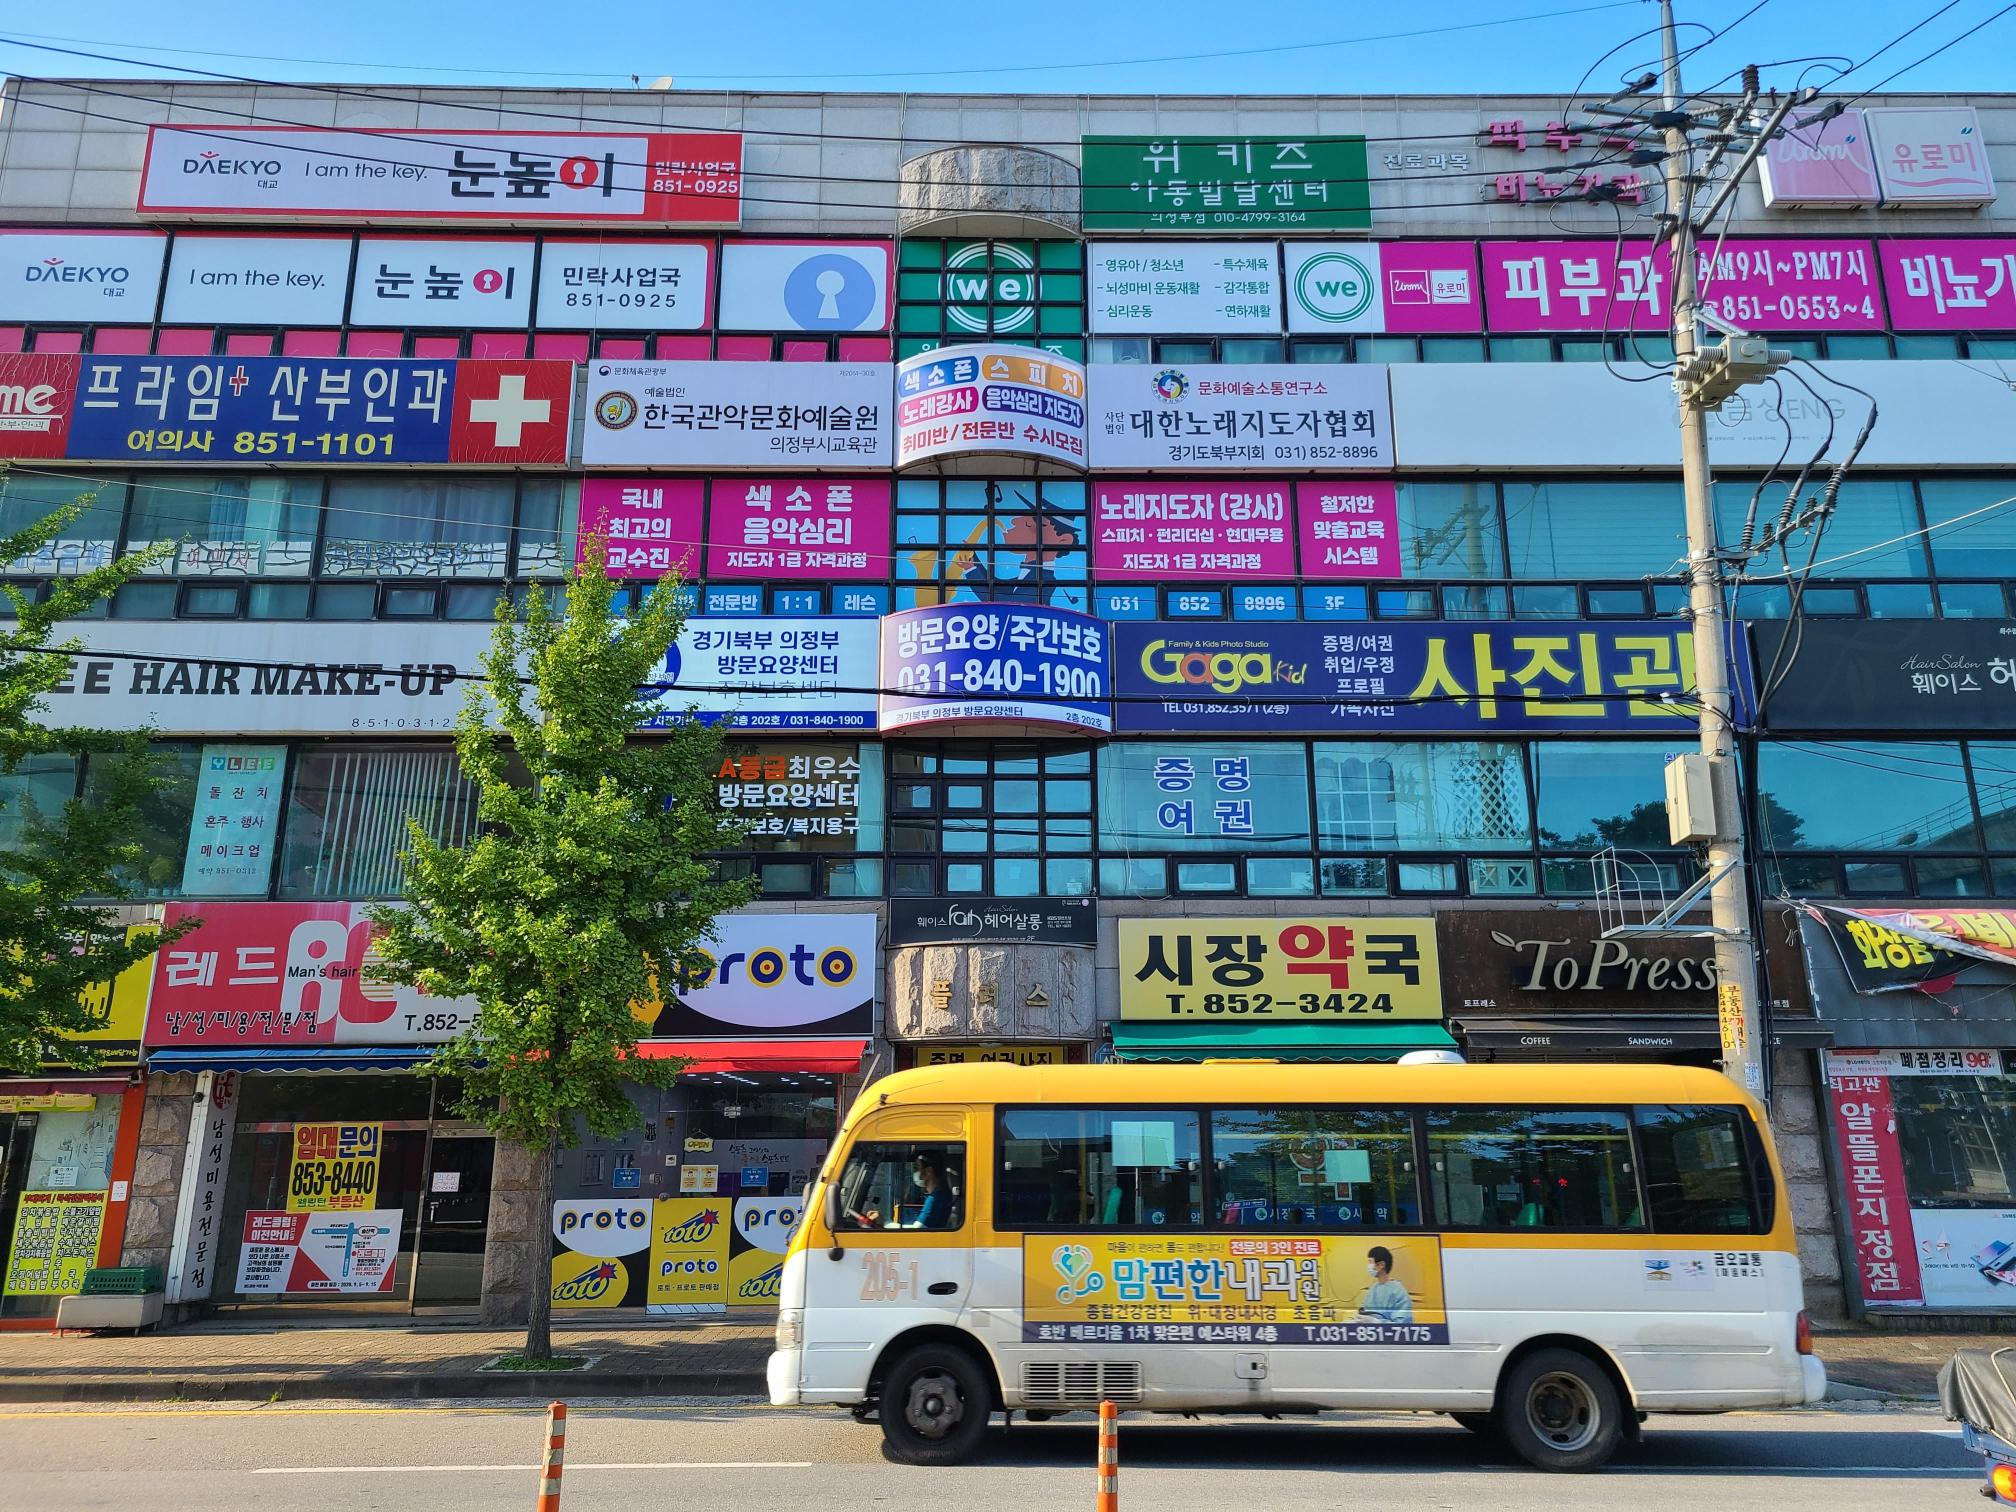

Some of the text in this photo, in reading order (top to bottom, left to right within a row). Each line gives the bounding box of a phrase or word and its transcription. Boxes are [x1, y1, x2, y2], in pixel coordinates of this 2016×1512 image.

[1143, 140, 1312, 174] 위키즈
[1383, 153, 1470, 170] 진료과목
[1892, 142, 1977, 173] 유로미
[183, 159, 281, 176] DAEKYO
[305, 163, 428, 183] I am the key.
[257, 180, 278, 189] 대교
[653, 178, 738, 194] 851-0925
[1130, 179, 1328, 206] 아동발달센터
[1214, 212, 1306, 223] 010-4799-3164
[1105, 259, 1184, 272] 영유아 청소년
[1222, 259, 1268, 272] 특수체육
[25, 267, 129, 283] DAEKYO
[190, 269, 326, 290] I am the key.
[563, 267, 681, 287] 민락사업국
[103, 287, 125, 297] 대교
[956, 279, 1022, 300] we
[1106, 282, 1200, 295] 뇌성마비 운동재활
[1224, 282, 1269, 294] 감각통합
[1315, 280, 1358, 297] we
[1435, 282, 1466, 293] 유로미
[1503, 256, 1663, 316] 피부과
[567, 293, 676, 308] 851-0925
[1107, 305, 1152, 318] 심리운동
[1225, 304, 1271, 317] 연하재활
[904, 360, 972, 391] 색소폰
[991, 359, 1078, 396] 스피치
[84, 365, 448, 423] 프라임 산부인과
[644, 387, 685, 398] 예술법인
[1198, 381, 1328, 396] 문화예술소통연구소
[903, 387, 973, 424] 노래강사
[986, 388, 1081, 426] 음악심리 지도자
[644, 404, 878, 431] 한국관악문화예술원
[1105, 412, 1125, 423] 사단
[1131, 409, 1376, 439] 대한노래지도자협회
[1105, 424, 1125, 435] 법인
[127, 430, 394, 456] 여의사 851-1101
[770, 436, 877, 454] 의정부시교육관
[1023, 424, 1083, 457] 수시모집
[1169, 445, 1378, 461] 경기도북부지회 031) 852-8896
[621, 489, 663, 510] 국내
[745, 485, 852, 511] 색소폰
[1101, 493, 1284, 521] 노래지도자 (강사)
[1320, 495, 1374, 513] 철저한
[609, 518, 671, 539] 최고의
[743, 518, 852, 545] 음악심리
[1102, 528, 1283, 544] 스피치 펀리더십 현대무용
[1313, 521, 1384, 540] 맞춤교육
[607, 548, 669, 569] 교수진
[727, 552, 867, 568] 지도자 1급 자격과정
[1123, 553, 1261, 570] 지도자 1급 자격과정
[1323, 547, 1378, 566] 시스템
[709, 594, 758, 611] 전문반
[845, 595, 876, 611] 레슨
[1110, 596, 1344, 611] 031 852 8896 3F
[692, 631, 840, 650] 경기북부 의정부
[1168, 640, 1193, 648] Family
[1202, 640, 1219, 648] Kids
[1220, 640, 1245, 648] Photo
[1246, 640, 1269, 648] Studio
[1322, 635, 1393, 653] 증명/여권
[717, 655, 839, 675] 방문요양센터
[1141, 639, 1272, 694] Gaga
[1325, 656, 1394, 674] 취업/우정
[129, 662, 456, 697] HAIR MAKE-UP
[1408, 632, 1698, 720] 사진관
[1911, 673, 1982, 695] 훼이스
[1337, 678, 1385, 695] 프로필
[751, 715, 864, 726] 202호 031-840-1900
[932, 707, 961, 718] 의정부
[963, 706, 1023, 717] 방문요양센터
[1066, 712, 1080, 723] 2층
[1081, 715, 1103, 728] 202호
[718, 756, 861, 780] A등급 최우수
[1154, 757, 1251, 792] 증명
[209, 787, 268, 799] 돌잔치
[718, 784, 860, 808] 방문요양센터
[241, 816, 264, 828] 행사
[1157, 800, 1254, 835] 여권
[201, 845, 260, 858] 메이크업
[984, 913, 1042, 930] 헤어살롱
[1134, 925, 1420, 989] 시장약국
[166, 947, 278, 987] 레드
[288, 965, 327, 978] Man's
[331, 965, 356, 978] hair
[679, 944, 857, 996] proto
[1464, 1000, 1496, 1008] 토프레소
[1521, 1036, 1672, 1046] COFFEE SANDWICH
[297, 1126, 379, 1160] 임대문의
[292, 1161, 376, 1196] 853-8440
[328, 1196, 365, 1209] 부동산
[253, 1217, 291, 1228] 레드클럽
[560, 1207, 647, 1234] proto
[251, 1229, 290, 1241] 이전안내
[1231, 1241, 1268, 1254] 전문의
[1271, 1241, 1291, 1254] 3인
[1294, 1241, 1320, 1254] 진료
[661, 1259, 718, 1276] proto
[860, 1252, 918, 1301] 205-1
[1087, 1304, 1172, 1321] 종합건강검진
[1294, 1304, 1337, 1321] 초음파
[1039, 1325, 1066, 1341] 호반
[1128, 1325, 1151, 1341] 1차
[1154, 1325, 1194, 1341] 맞은편
[1255, 1326, 1278, 1342] 4층
[1304, 1326, 1431, 1343] T.031-851-7175
